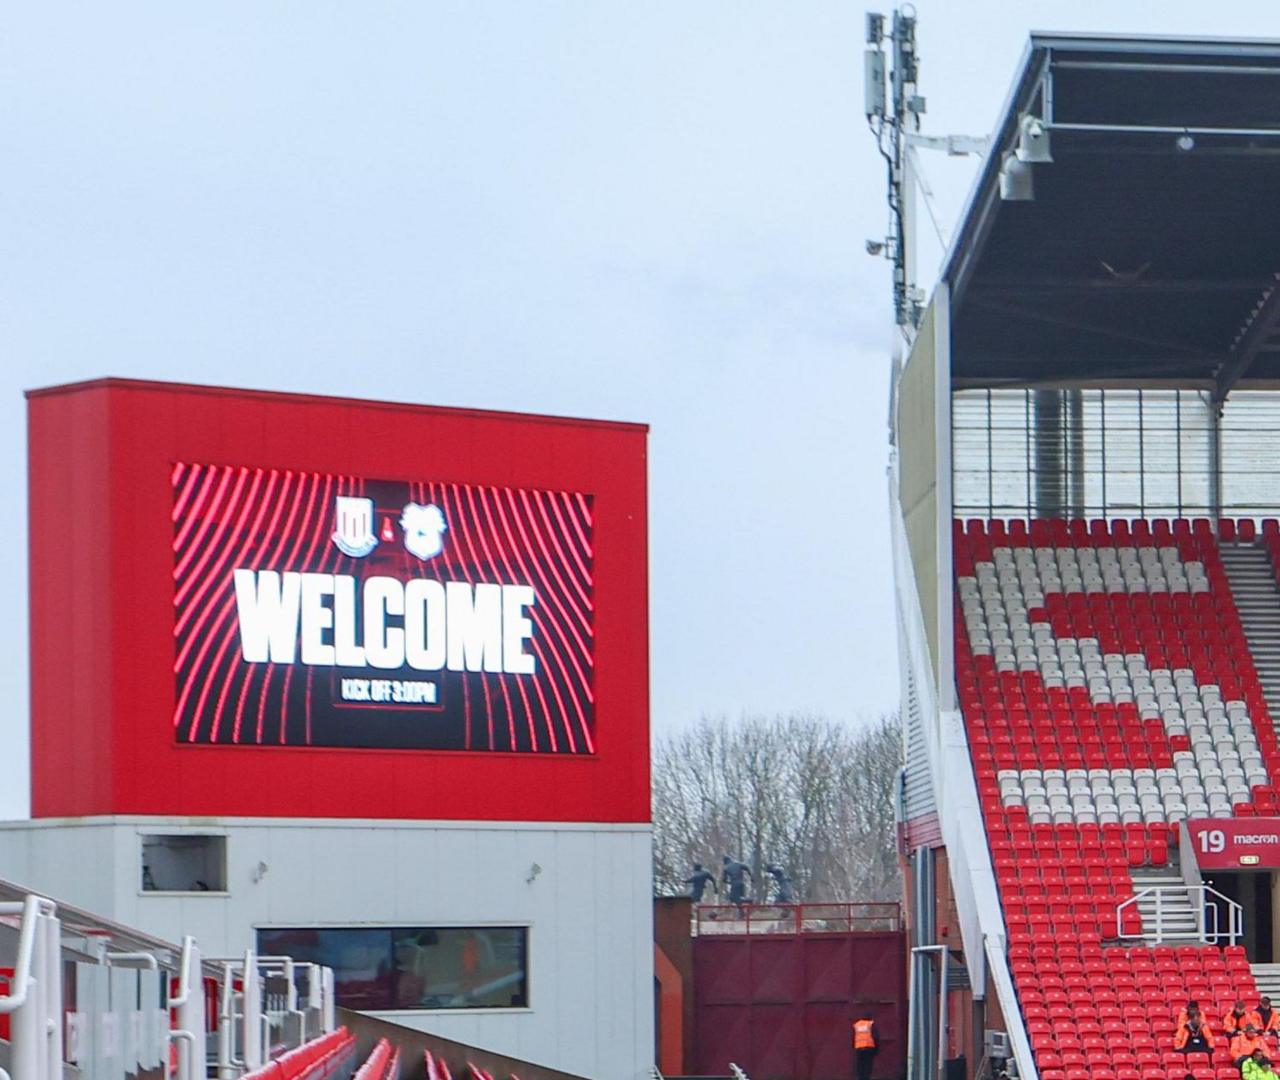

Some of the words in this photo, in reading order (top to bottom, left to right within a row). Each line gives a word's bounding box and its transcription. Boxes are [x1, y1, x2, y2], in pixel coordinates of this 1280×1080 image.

[234, 568, 536, 674] WELCOME
[342, 678, 370, 700] KICK
[1197, 830, 1225, 853] 19
[1233, 833, 1278, 845] macron
